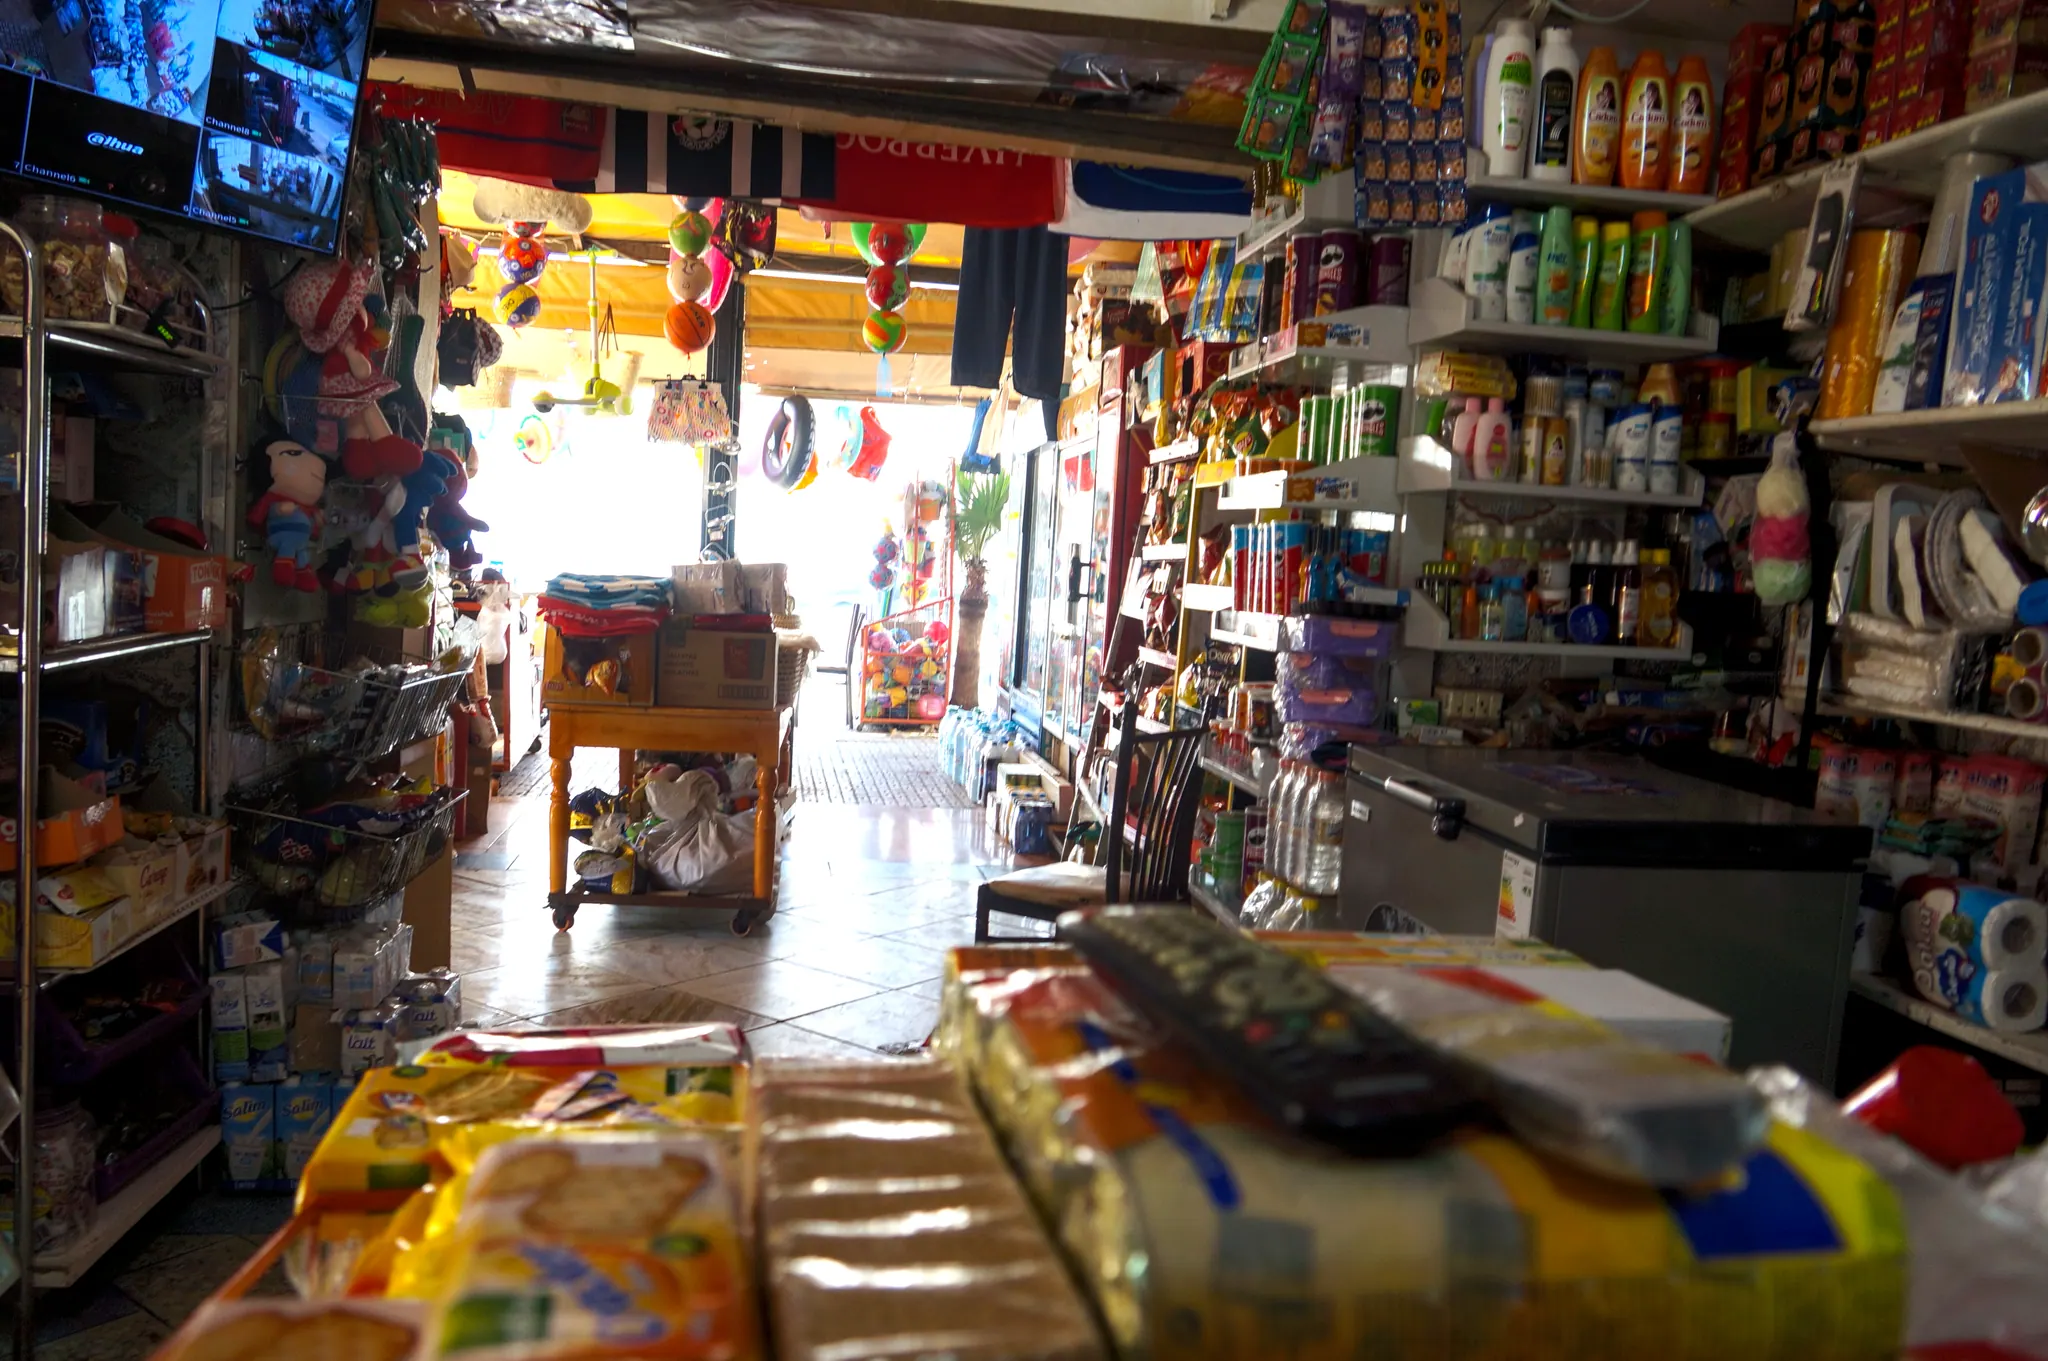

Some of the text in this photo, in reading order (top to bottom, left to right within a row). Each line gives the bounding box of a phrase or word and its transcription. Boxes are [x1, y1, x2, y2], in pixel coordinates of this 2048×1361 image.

[205, 115, 250, 136] Channel8
[24, 163, 76, 184] Channel6
[192, 206, 237, 224] Channel5
[1208, 648, 1238, 665] Dorito
[222, 1100, 267, 1121] Salim
[281, 1098, 324, 1117] Salim
